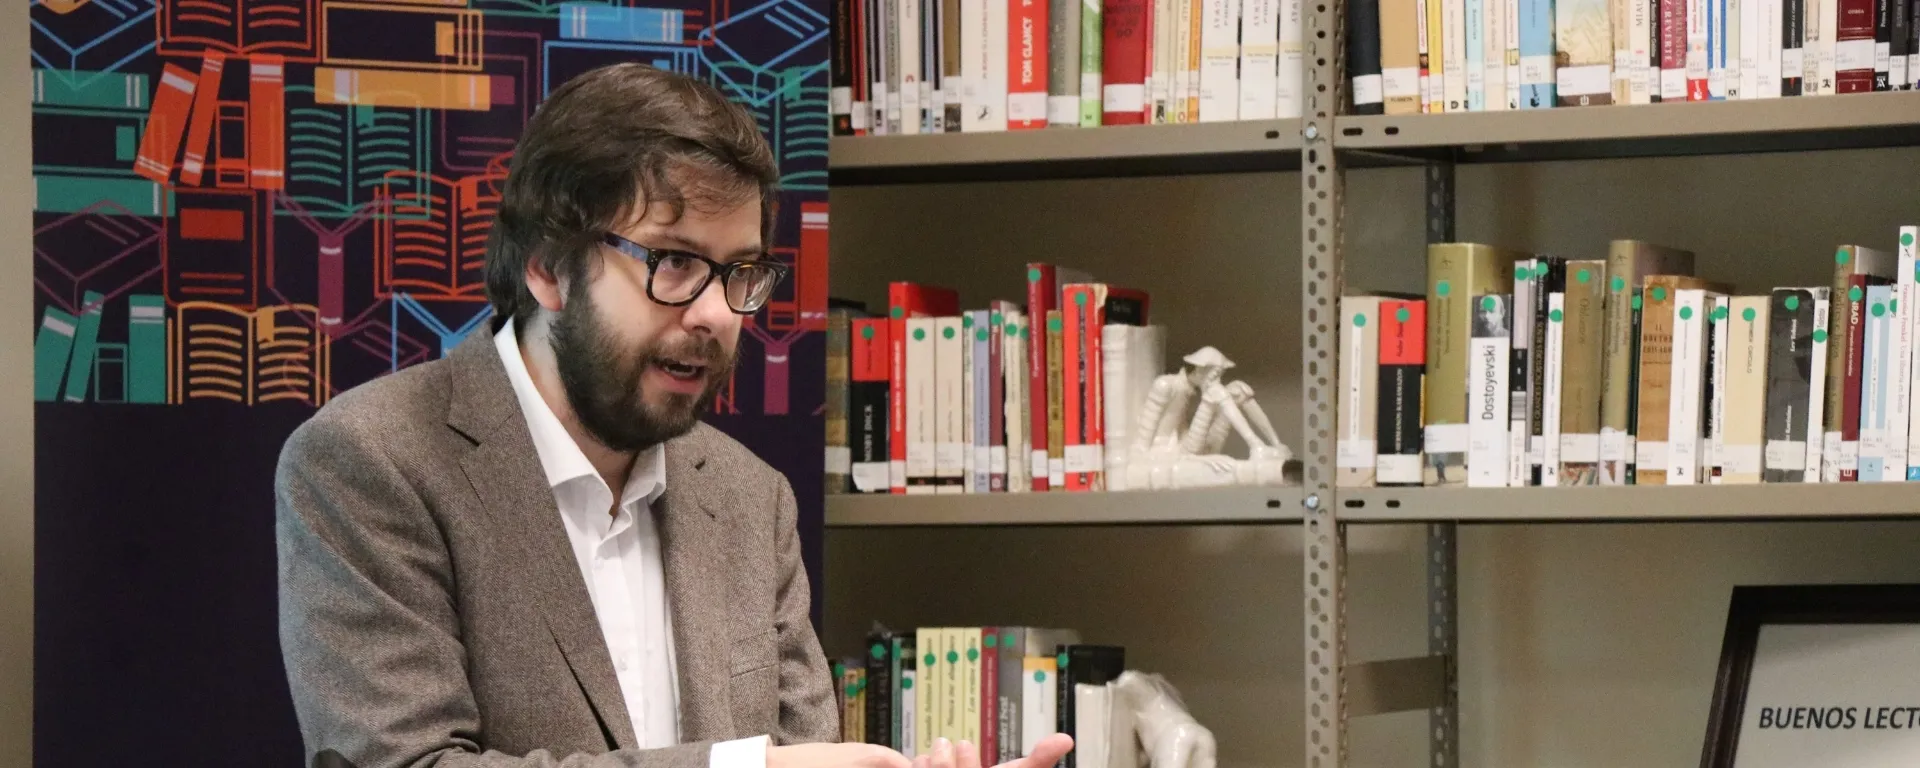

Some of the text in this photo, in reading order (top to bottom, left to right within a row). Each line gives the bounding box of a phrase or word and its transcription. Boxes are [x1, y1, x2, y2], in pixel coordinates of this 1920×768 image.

[1022, 17, 1033, 85] TOM CLANCY
[1482, 345, 1498, 420] Dostoyevski
[864, 405, 872, 431] DICK
[1759, 707, 1857, 729] BUENOS
